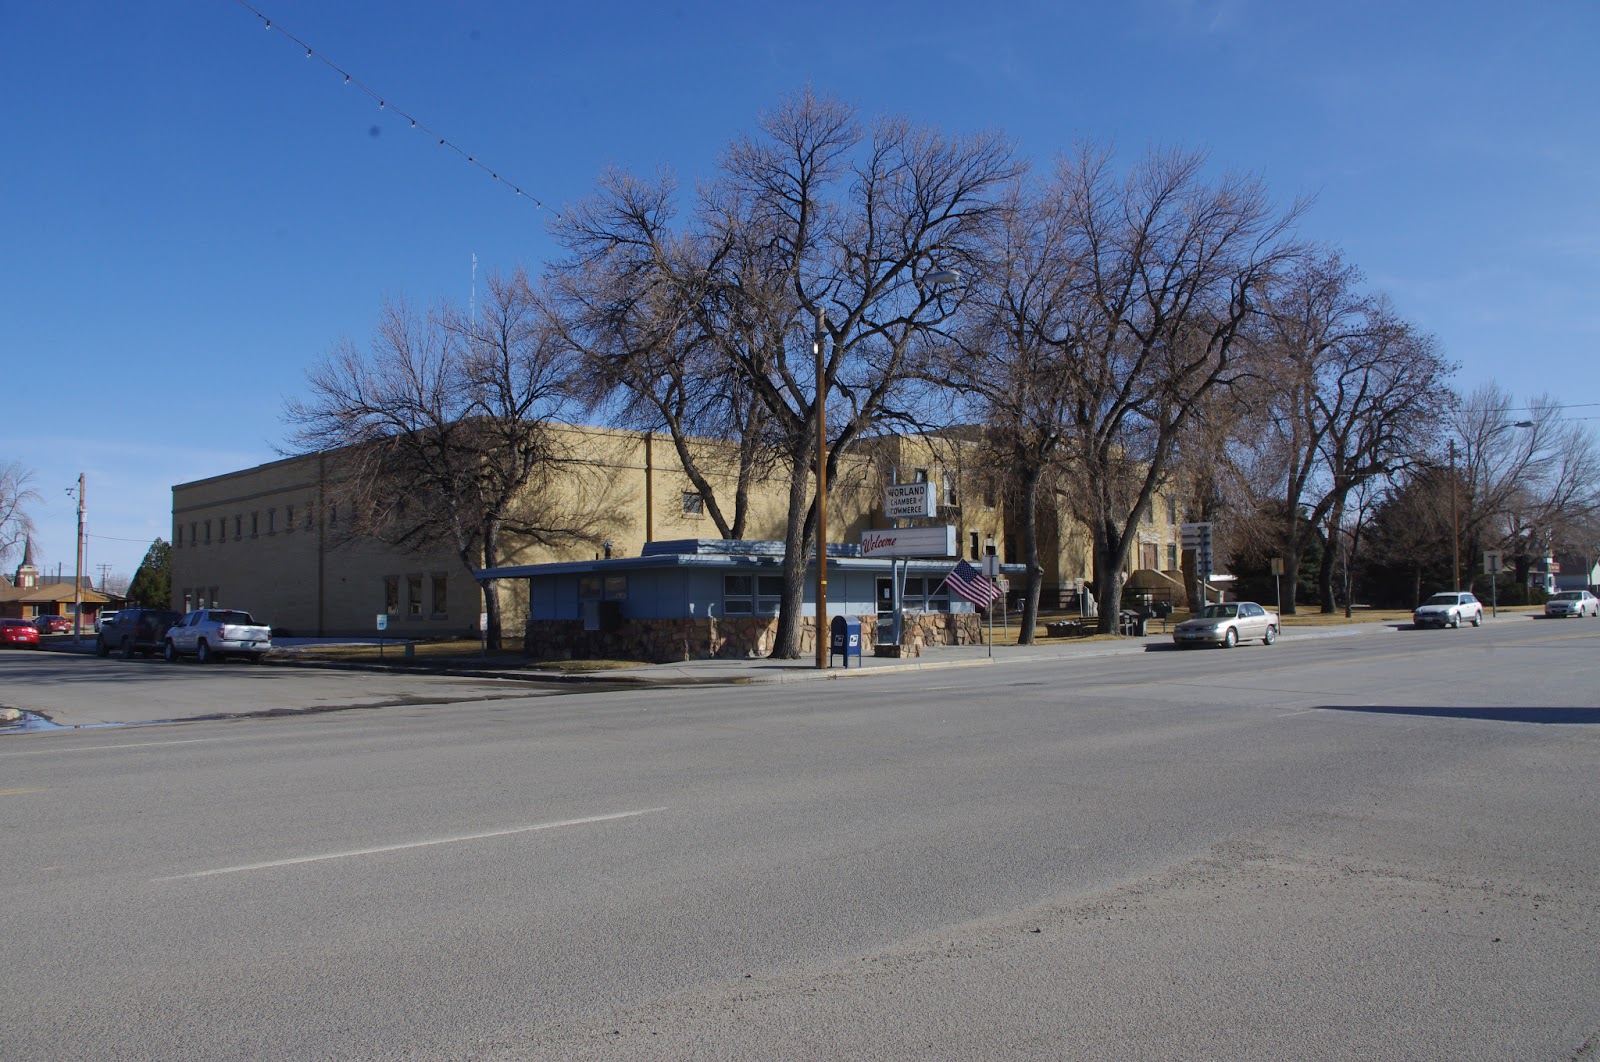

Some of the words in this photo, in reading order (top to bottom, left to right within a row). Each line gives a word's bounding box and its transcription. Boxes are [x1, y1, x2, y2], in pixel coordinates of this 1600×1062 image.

[887, 486, 924, 497] WORLAND
[890, 498, 916, 506] CHAMBER
[890, 505, 922, 515] COMMERCE
[862, 533, 897, 554] Welcome
